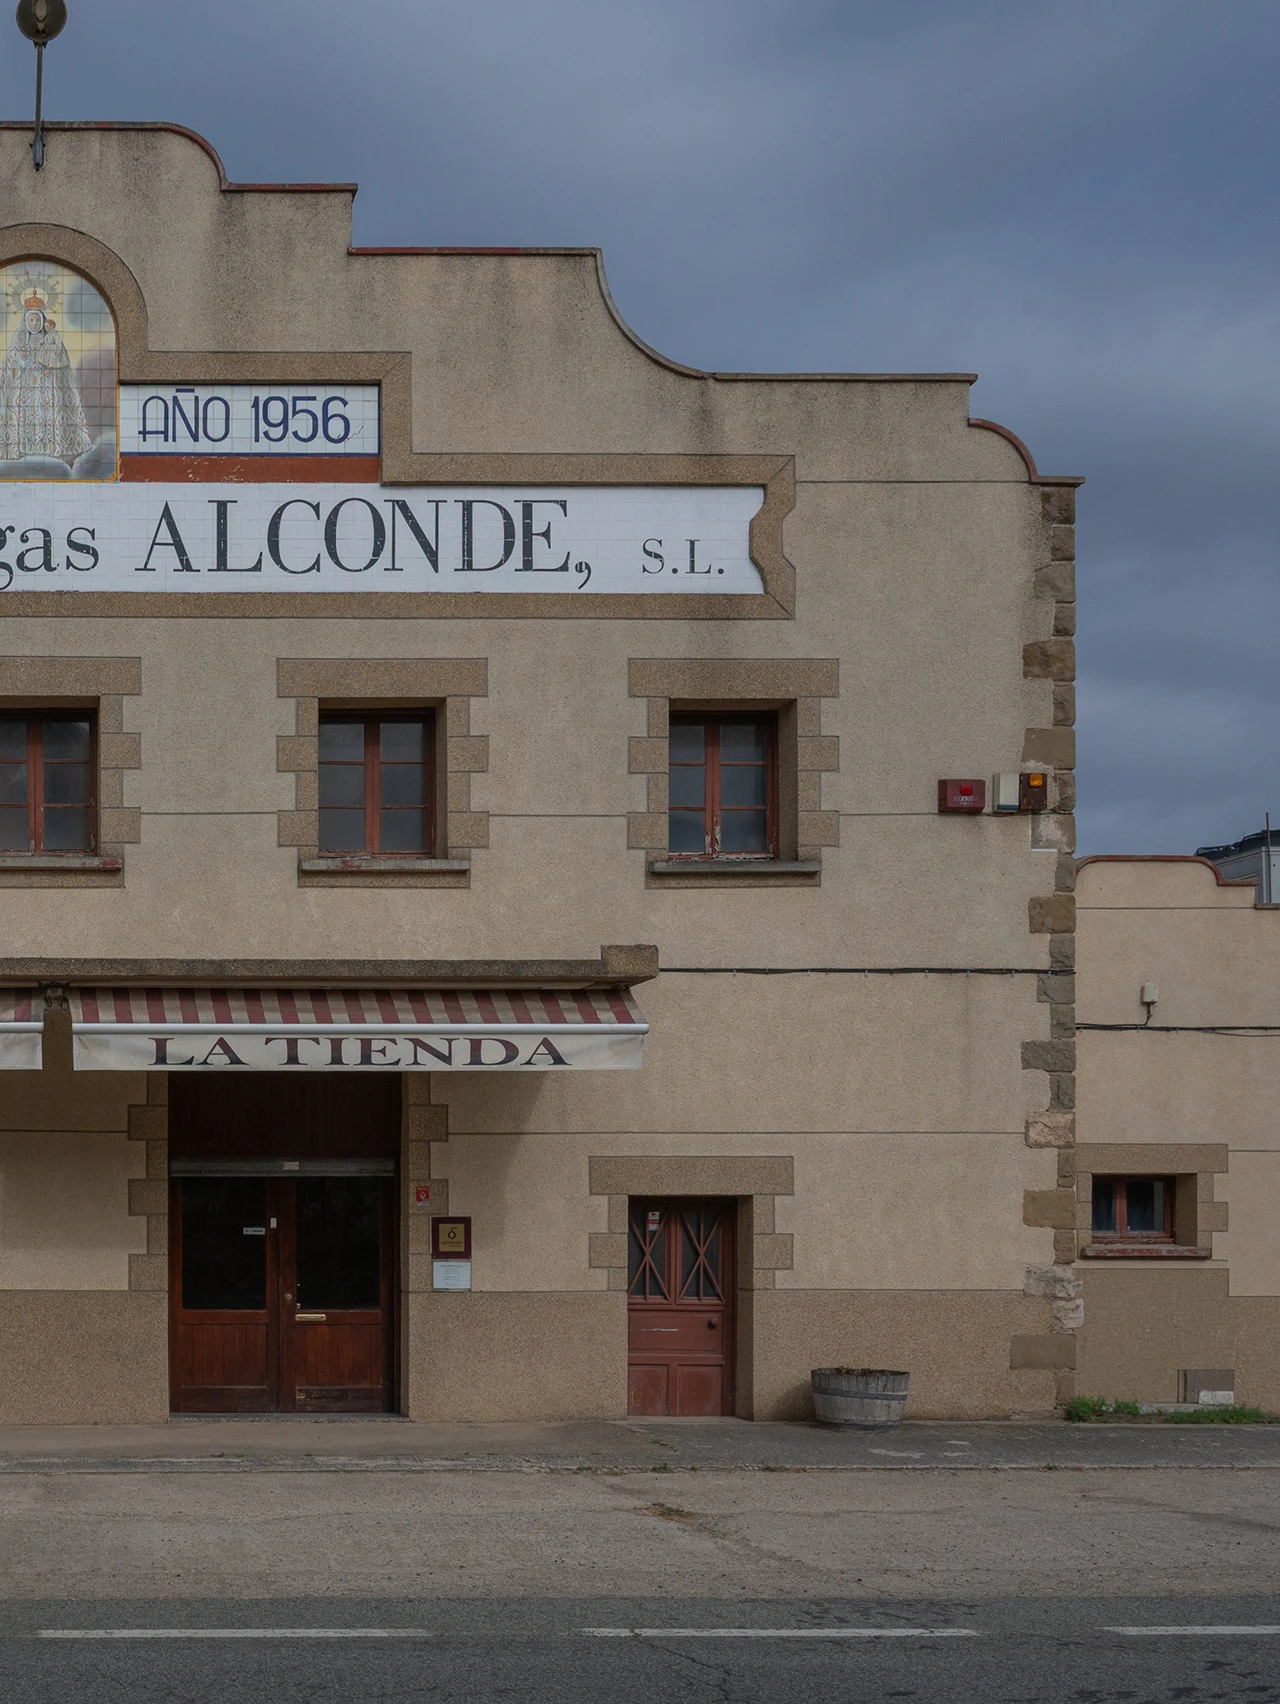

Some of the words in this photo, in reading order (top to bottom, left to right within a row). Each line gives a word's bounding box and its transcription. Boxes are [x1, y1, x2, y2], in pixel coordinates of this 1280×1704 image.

[137, 387, 231, 443] AÑO
[250, 394, 351, 444] 1956
[134, 497, 592, 590] ALCONDE,
[641, 538, 725, 575] S.L.
[147, 1036, 250, 1066] LA
[264, 1036, 573, 1066] TIENDA
